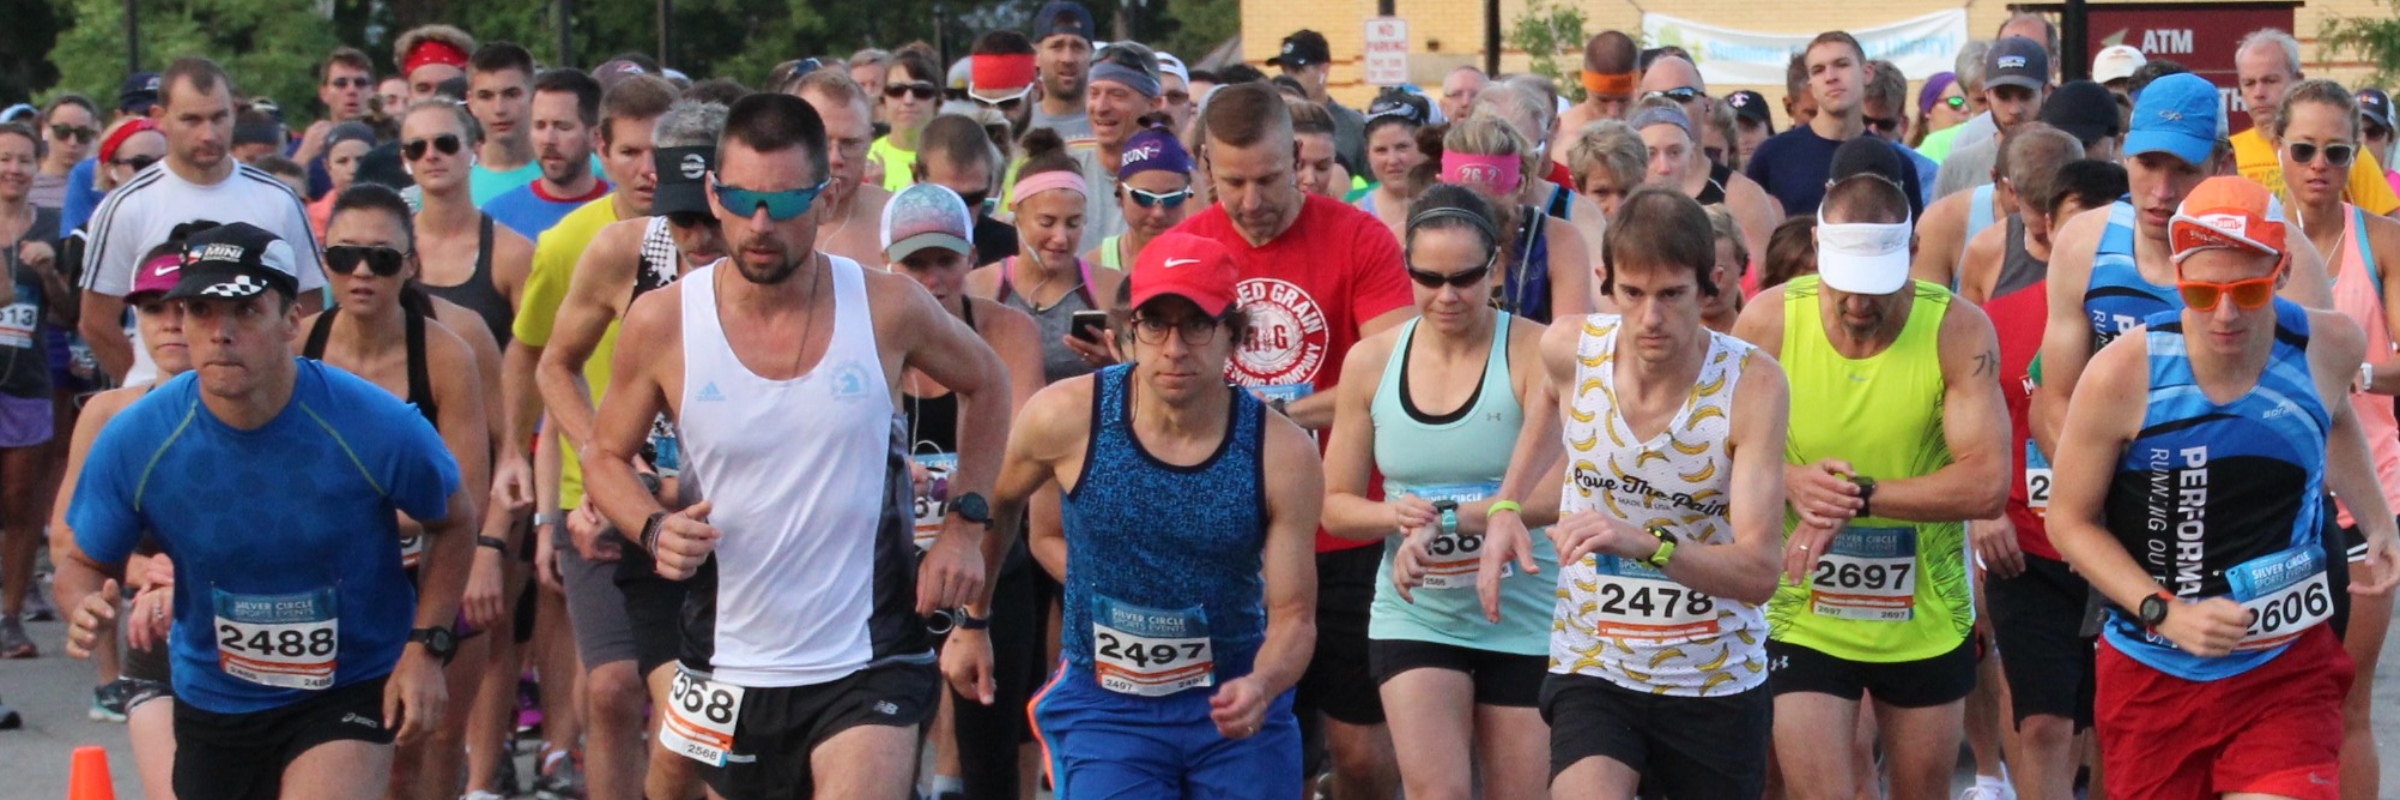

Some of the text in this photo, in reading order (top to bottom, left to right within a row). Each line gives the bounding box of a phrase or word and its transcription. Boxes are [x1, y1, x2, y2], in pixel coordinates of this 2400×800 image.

[2141, 29, 2194, 54] ATM
[206, 246, 243, 258] MINI
[1269, 282, 1323, 335] GRAIN
[2022, 377, 2035, 396] M
[1622, 475, 1670, 500] The
[2030, 475, 2050, 501] 2
[1428, 534, 1482, 556] 58
[1865, 535, 1898, 545] CIRCLE
[1813, 560, 1911, 591] 2697
[2252, 551, 2311, 580] SILVER CIRCLE
[234, 600, 314, 610] SILVER CIRCLE
[1601, 583, 1713, 618] 2478
[1818, 604, 1906, 620] 2697 2697
[2246, 582, 2329, 635] 2606
[1112, 608, 1185, 626] SILVER CIRCLE
[220, 624, 335, 657] 2488
[1098, 632, 1206, 668] 2497
[673, 668, 735, 725] 568
[1106, 678, 1133, 691] 2497
[687, 744, 718, 760] 2568
